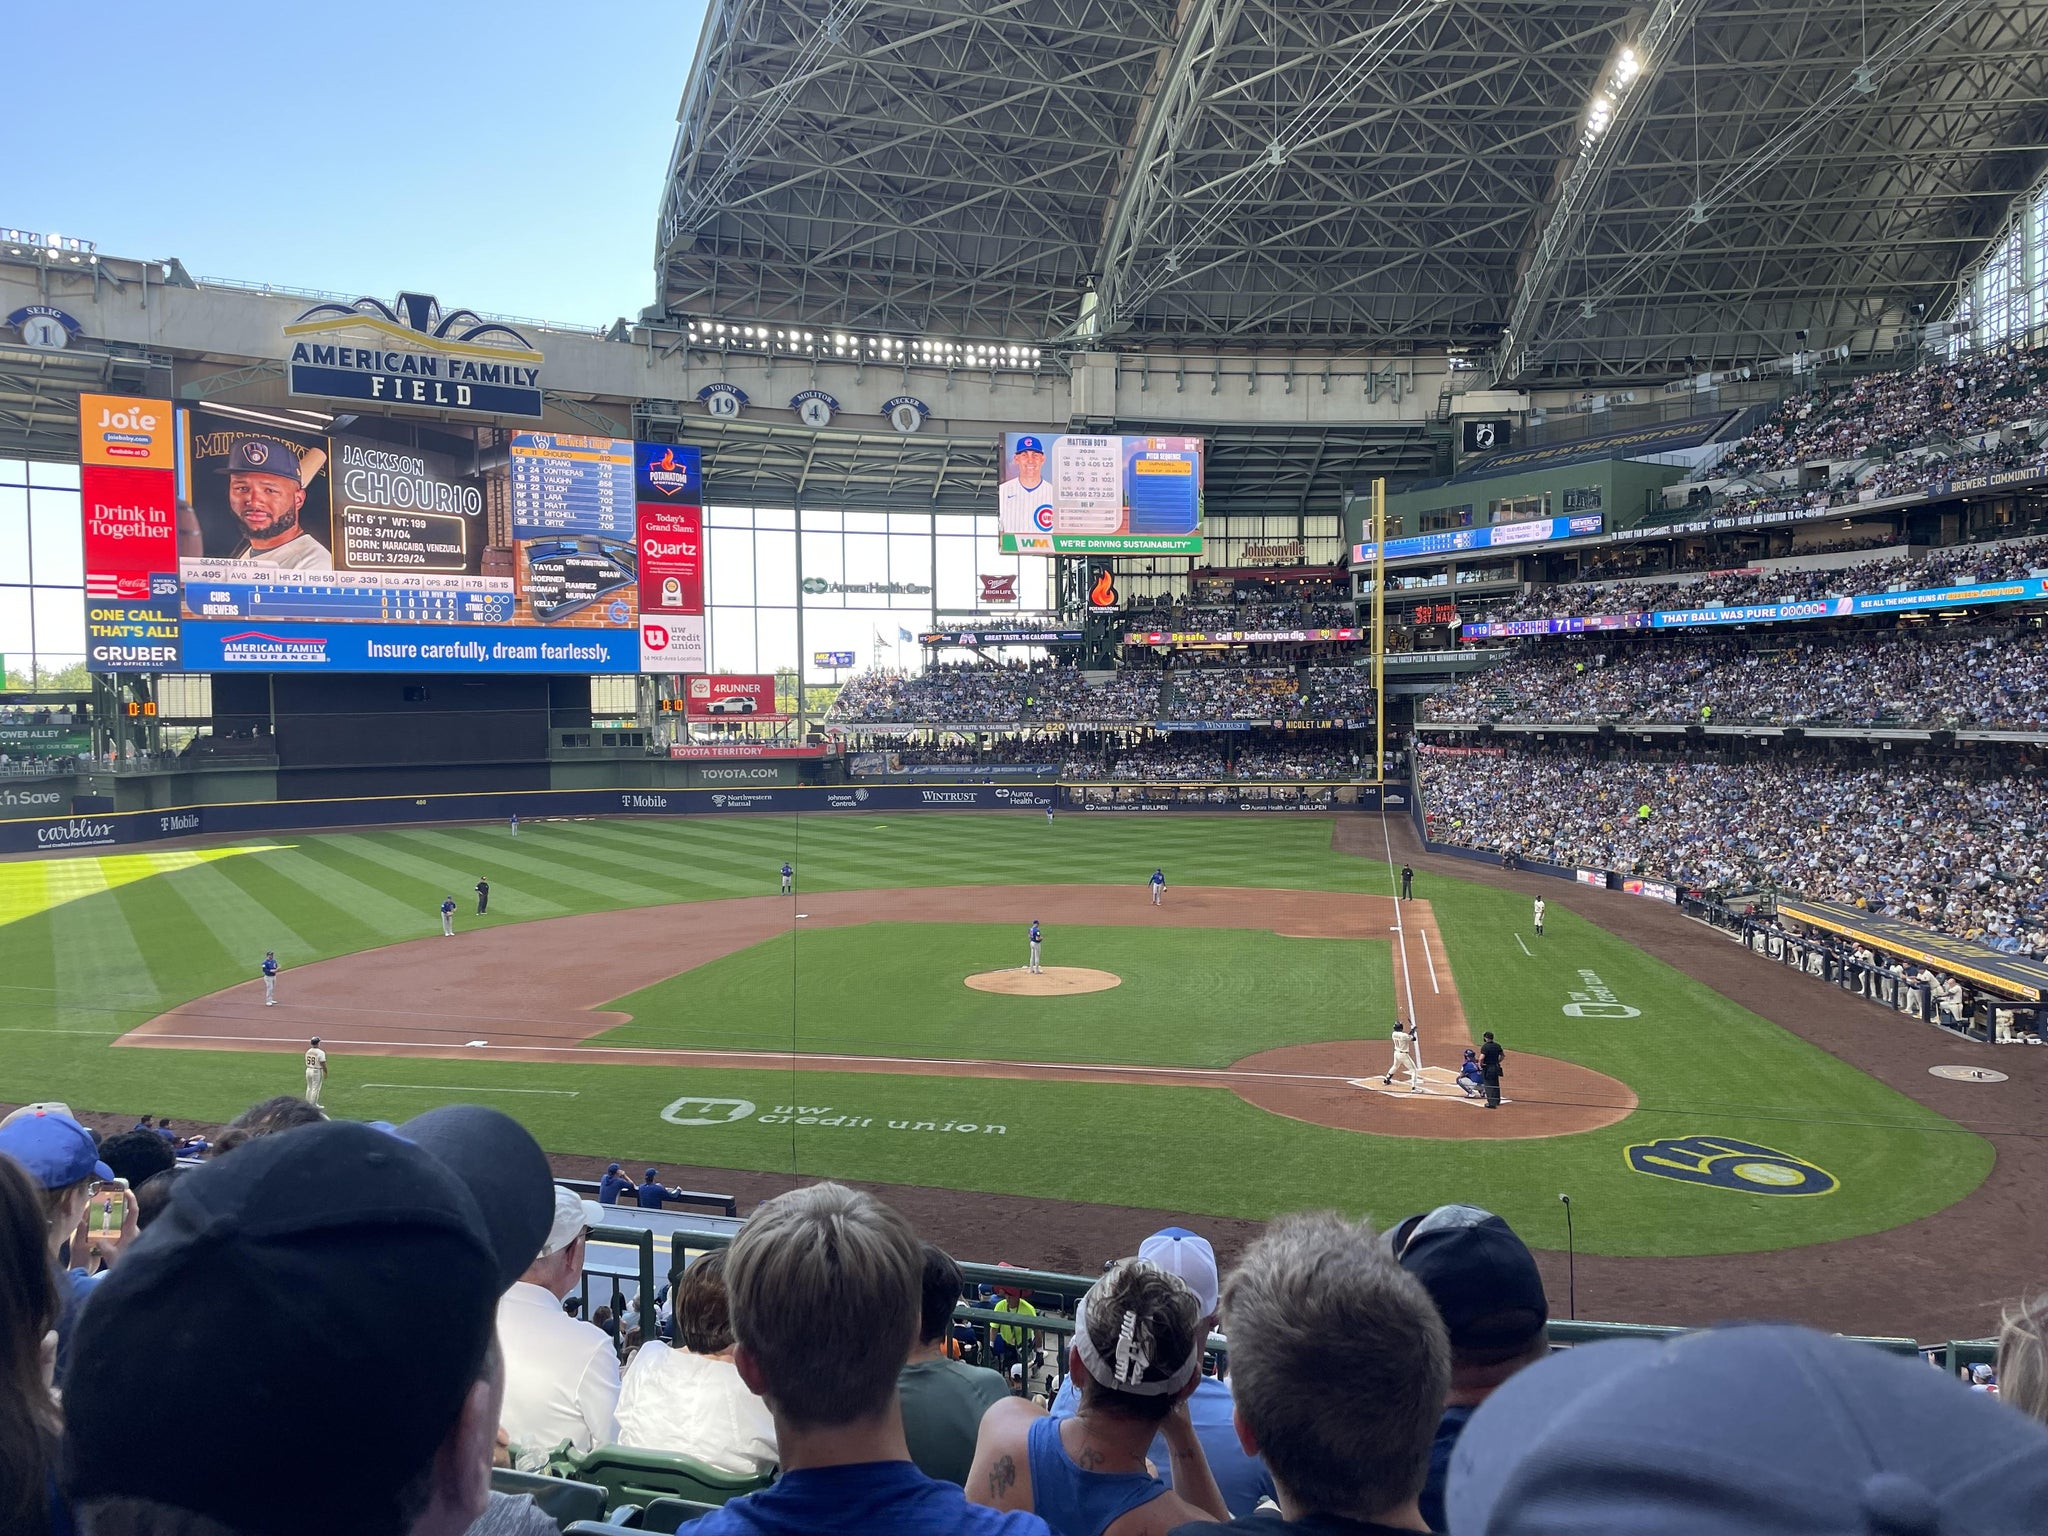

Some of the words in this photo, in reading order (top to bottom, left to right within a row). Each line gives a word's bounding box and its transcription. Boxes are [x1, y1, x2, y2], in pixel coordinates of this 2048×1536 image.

[26, 305, 62, 319] SELIG
[39, 324, 52, 346] 1
[292, 341, 438, 377] AMERICAN
[448, 359, 540, 388] FAMILY
[371, 376, 472, 407] FIELD
[709, 384, 737, 394] YOUNT
[797, 391, 833, 404] MOLITOR
[890, 398, 920, 408] UECKER
[713, 397, 735, 415] 19
[809, 404, 819, 421] 4
[98, 407, 156, 431] Joie
[107, 434, 149, 443] joiebaby.com
[544, 450, 572, 458] CHOURIO
[343, 445, 424, 476] JACKSON
[544, 459, 572, 467] TURANG
[544, 468, 584, 477] CONTRERAS
[650, 471, 687, 484] POTAWATOMI
[544, 476, 572, 484] VAUGHN
[1951, 477, 1987, 492] BREWERS
[1990, 467, 2040, 485] COMMUNITY
[344, 470, 482, 516] CHOURIO
[544, 485, 568, 493] YELICH
[544, 502, 568, 510] PRATT
[94, 504, 145, 521] Drink
[149, 506, 165, 522] in
[544, 510, 576, 518] MITCHELL
[348, 513, 363, 523] HT:
[392, 517, 409, 527] WT:
[410, 518, 427, 529] 199
[655, 514, 685, 524] Today's
[89, 519, 172, 539] Together
[348, 526, 372, 536] DOB:
[375, 528, 411, 539] 3/11/04
[645, 522, 671, 532] Grand
[672, 524, 695, 533] Slam:
[349, 539, 380, 550] BORN:
[382, 541, 424, 553] MARACAIBO,
[426, 543, 461, 553] VENEZUELA
[644, 539, 696, 558] Quartz
[1021, 539, 1049, 548] WM
[1060, 539, 1082, 548] WE'RE
[1083, 540, 1121, 548] DRIVING
[1123, 541, 1187, 549] SUSTAINABILITY
[1241, 541, 1305, 559] Johnsonville
[200, 559, 231, 567] SEASON
[349, 552, 384, 563] DEBUT:
[387, 553, 425, 563] 3/29/24
[533, 563, 564, 572] TAYLOR
[201, 571, 221, 579] 495
[531, 575, 565, 583] HOERNER
[522, 585, 558, 593] BREGMAN
[565, 582, 597, 590] RAMIREZ
[830, 581, 865, 593] Aurora
[869, 581, 903, 594] Health
[906, 583, 931, 594] Care
[210, 591, 231, 602] CUBS
[565, 592, 597, 600] MURRAY
[1885, 598, 1897, 606] THE
[1898, 596, 1916, 605] HOME
[1918, 595, 1936, 604] RUNS
[90, 609, 124, 621] ONE
[128, 609, 177, 621] CALL...
[202, 604, 239, 616] BREWERS
[1661, 614, 1688, 624] THAT
[1691, 612, 1717, 622] BALL
[1719, 610, 1744, 620] WAS
[1746, 608, 1777, 618] PURE
[1780, 603, 1819, 616] POWER
[1556, 619, 1571, 631] 71
[90, 625, 143, 637] THAT'S
[146, 626, 179, 637] ALL!
[671, 632, 700, 641] credit
[1183, 633, 1207, 642] safe.
[1216, 632, 1232, 641] Call
[1244, 632, 1272, 641] before
[1273, 633, 1288, 642] you
[1289, 632, 1307, 641] dig.
[224, 643, 284, 653] AMERICAN
[286, 644, 326, 653] FAMILY
[672, 641, 701, 650] union
[93, 646, 177, 661] GRUBER
[367, 640, 418, 659] Insure
[420, 641, 490, 662] carefully,
[492, 641, 538, 661] dream
[540, 643, 611, 663] fearlessly.
[713, 684, 761, 694] 4RUNNER
[1045, 722, 1066, 731] 620
[1067, 722, 1098, 731] WTMJ
[1205, 721, 1246, 729] WINTRUST
[1285, 720, 1314, 729] NICOLET
[1316, 720, 1332, 728] LAW
[0, 731, 28, 739] OWER
[30, 730, 59, 738] ALLEY
[673, 748, 710, 757] TOYOTA
[712, 747, 763, 756] TERRITORY
[701, 768, 778, 779] TOYOTA.COM
[20, 791, 60, 805] Save
[922, 790, 976, 801] WINTRUST
[1010, 790, 1033, 798] Aurora
[633, 794, 667, 808] Mobile
[1010, 797, 1032, 805] Health
[170, 814, 199, 830] Mobile
[38, 818, 115, 842] carbliss
[773, 1105, 832, 1116] uw
[757, 1114, 873, 1128] credit
[888, 1120, 1007, 1135] union
